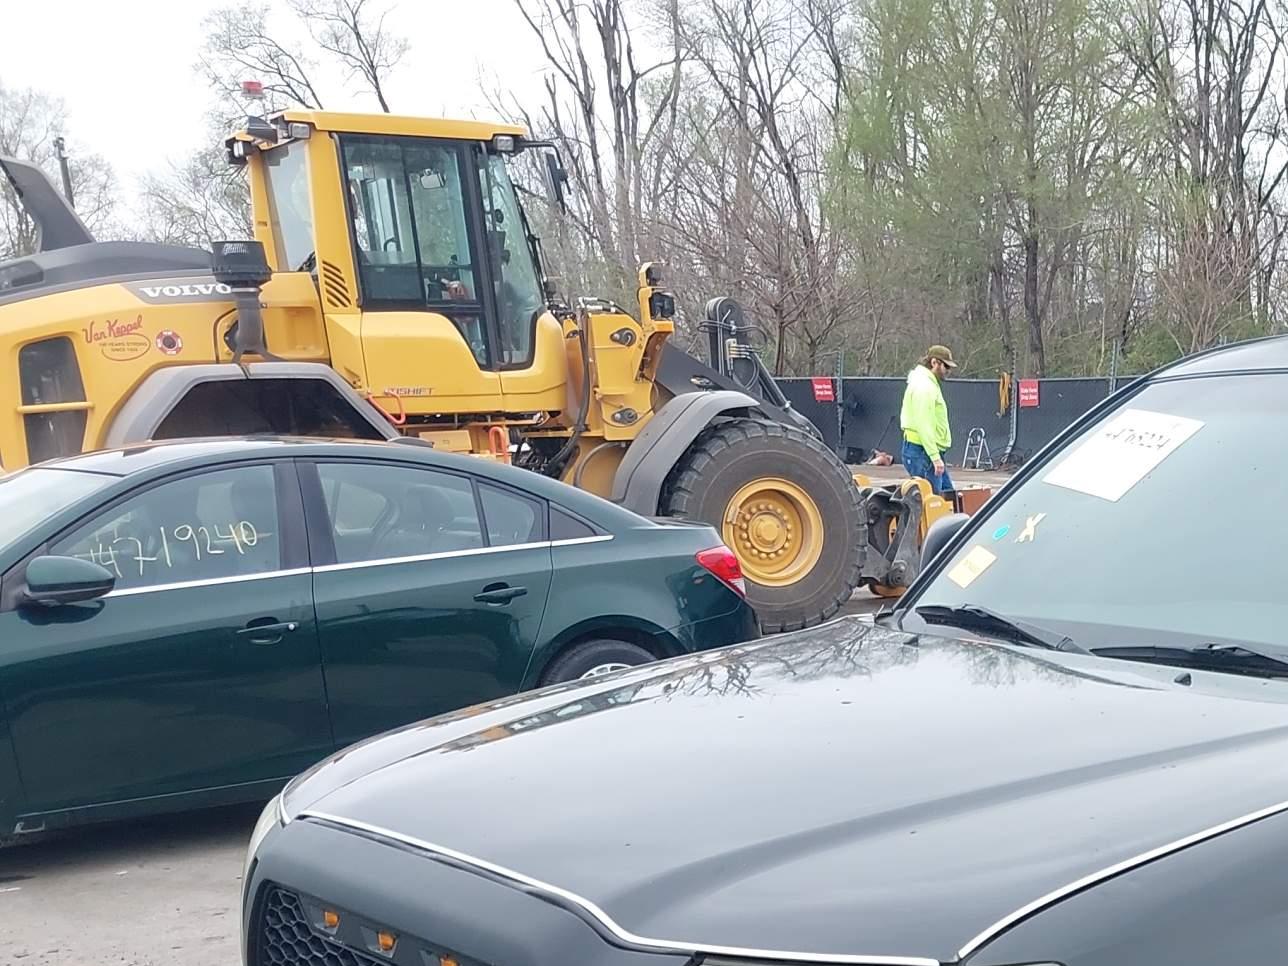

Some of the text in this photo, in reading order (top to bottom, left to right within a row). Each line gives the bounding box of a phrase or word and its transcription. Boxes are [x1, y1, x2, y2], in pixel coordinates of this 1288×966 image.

[139, 283, 232, 298] VOLVO
[82, 314, 143, 344] Van Keppel
